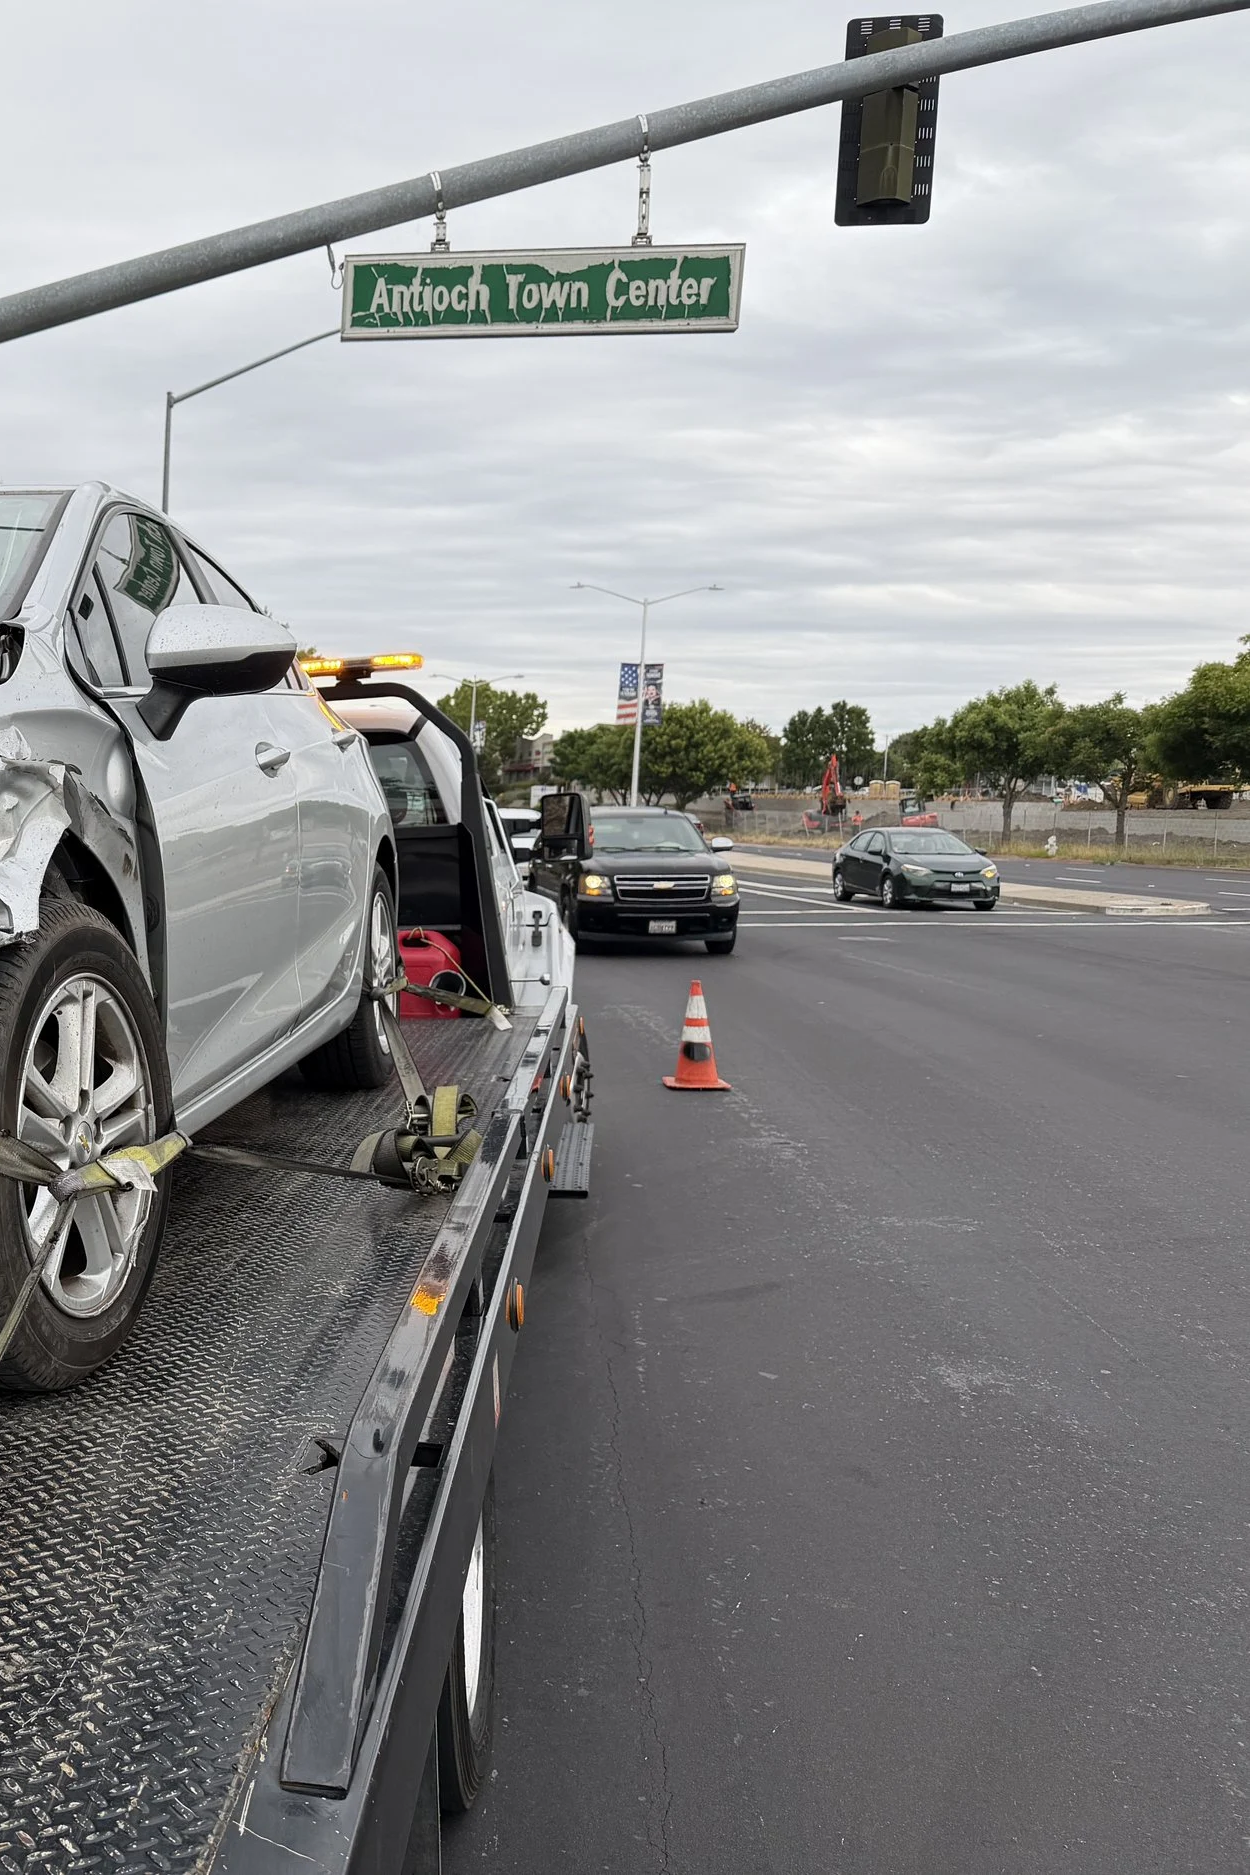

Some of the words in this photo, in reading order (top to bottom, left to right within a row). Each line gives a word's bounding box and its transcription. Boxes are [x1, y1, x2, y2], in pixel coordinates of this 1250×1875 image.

[369, 272, 488, 313] Antioch
[506, 273, 589, 310] Town
[605, 268, 717, 307] Center
